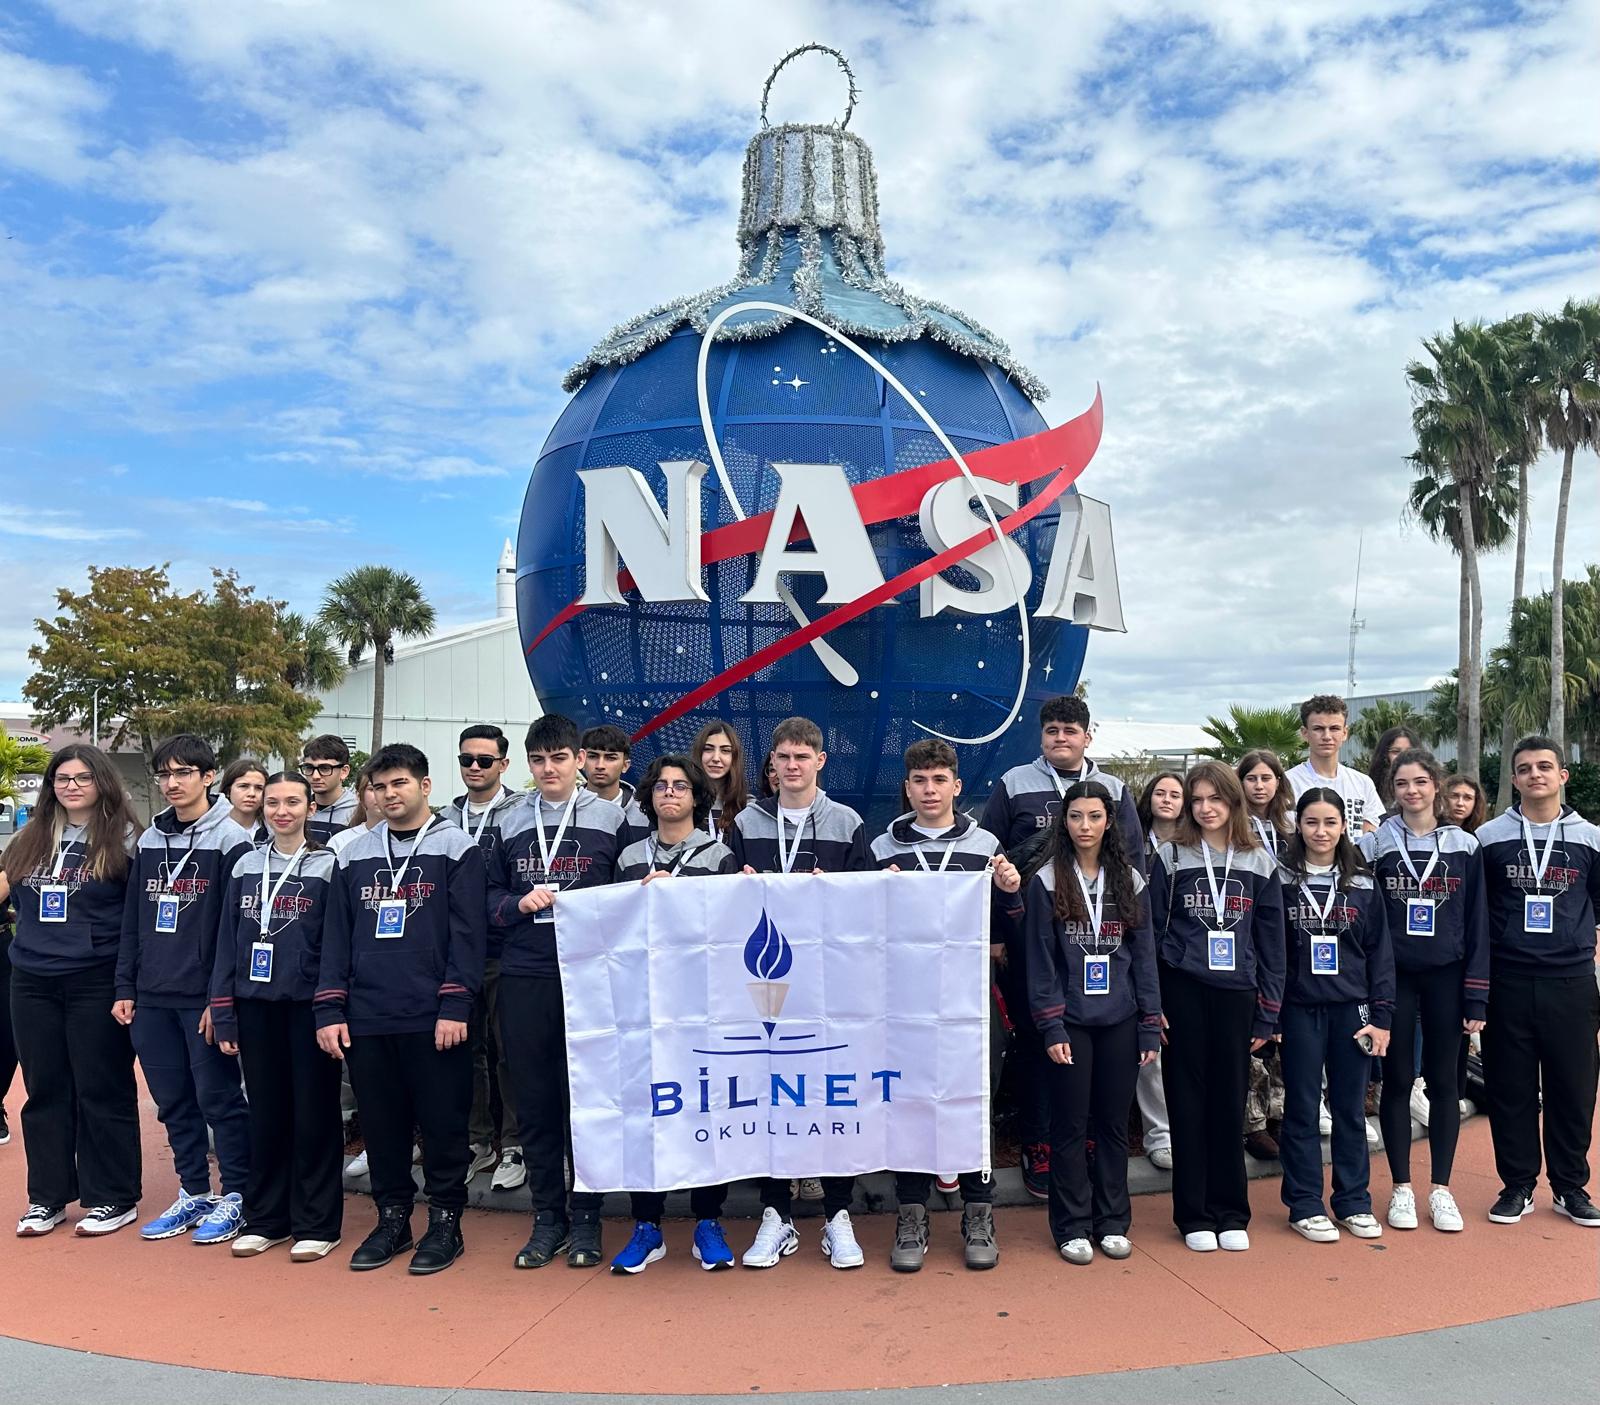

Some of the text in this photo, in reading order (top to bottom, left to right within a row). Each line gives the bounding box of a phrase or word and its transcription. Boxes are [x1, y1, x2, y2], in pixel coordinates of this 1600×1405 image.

[576, 460, 1127, 632] NASA
[240, 891, 313, 912] BİNET
[650, 1066, 902, 1117] BİLNET
[694, 1121, 860, 1142] OKULLARI
